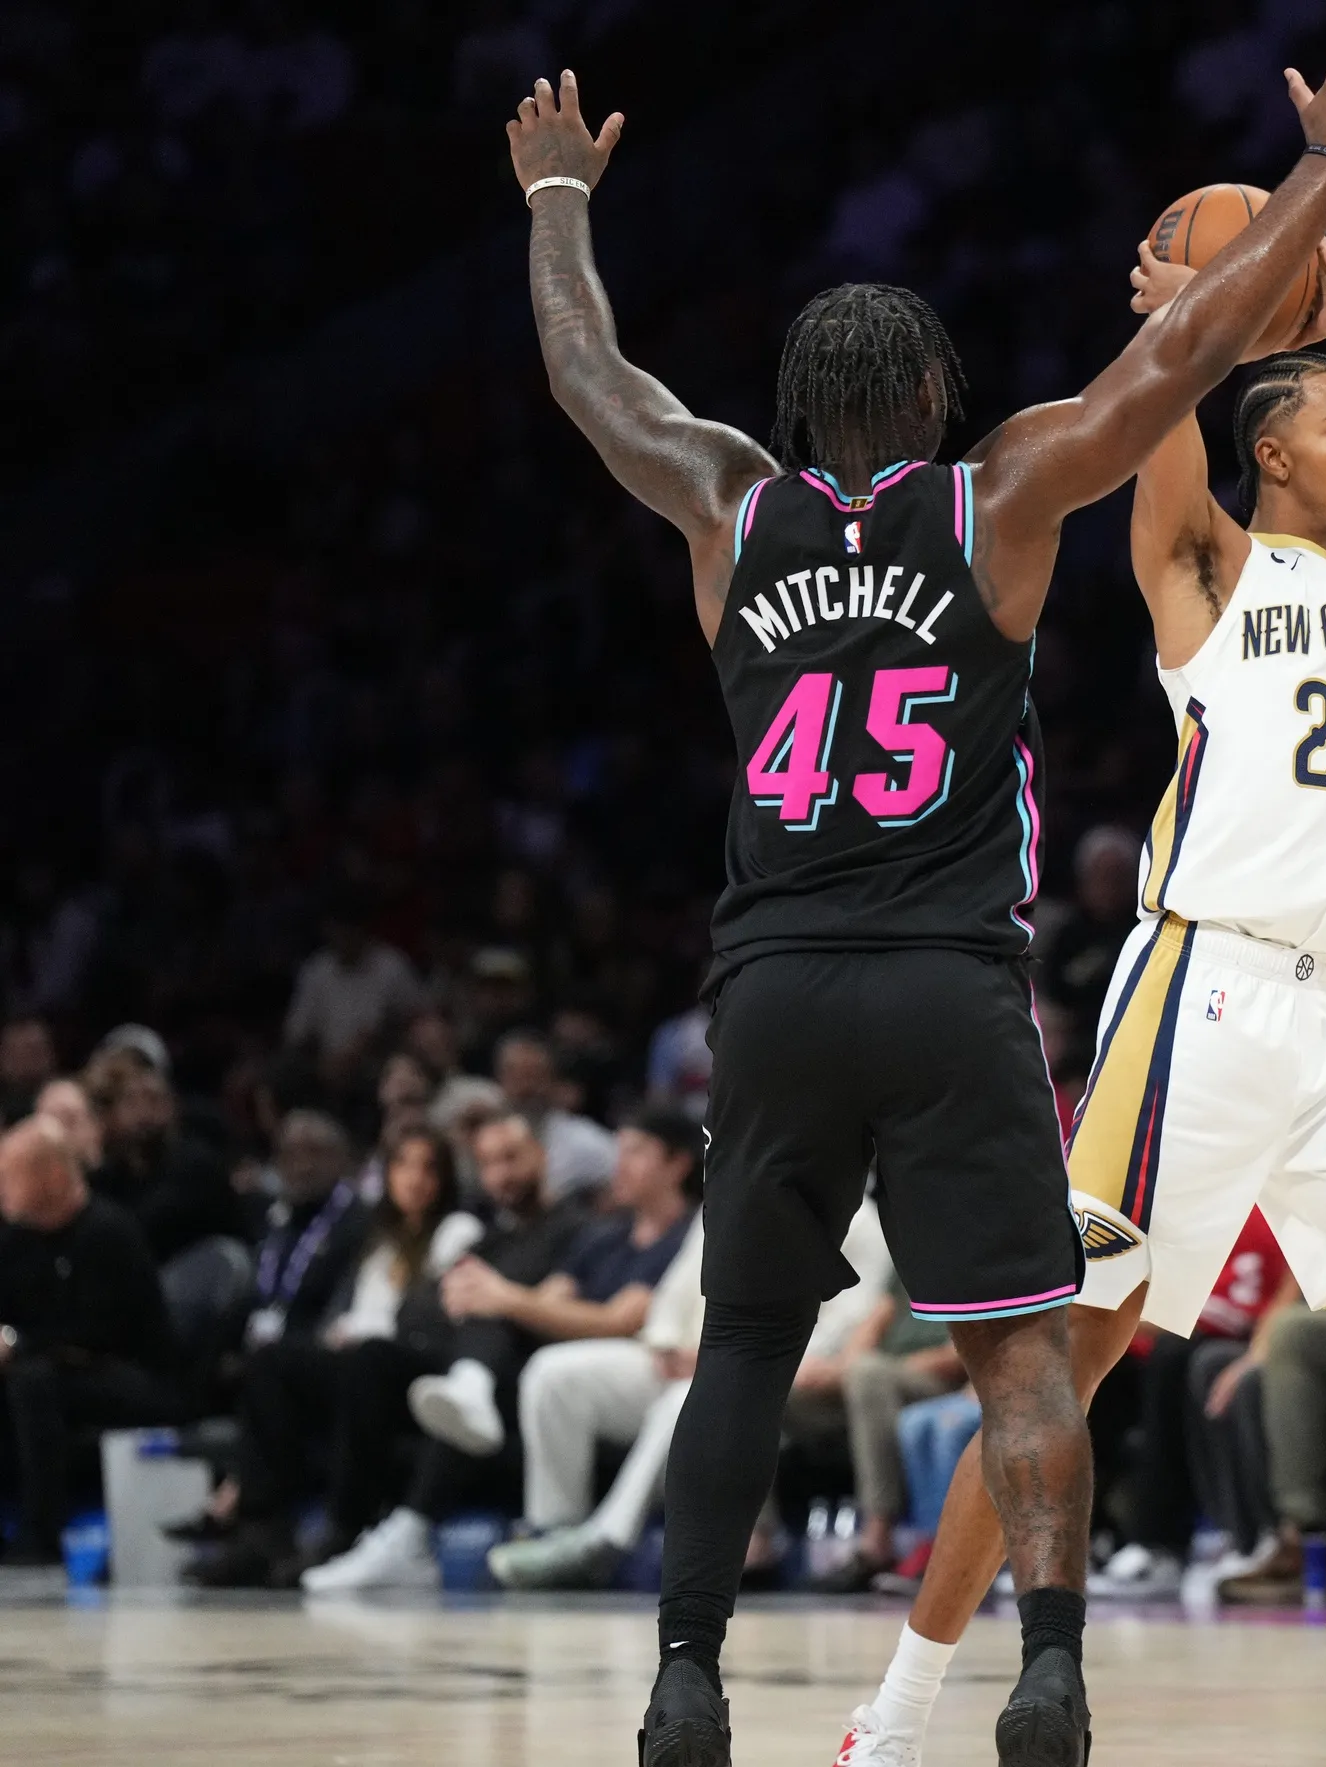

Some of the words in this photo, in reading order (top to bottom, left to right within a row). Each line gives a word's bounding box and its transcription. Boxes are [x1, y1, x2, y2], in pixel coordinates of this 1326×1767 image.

[738, 565, 955, 653] MITCHELL
[1242, 604, 1311, 661] NEW
[746, 665, 958, 831] 45
